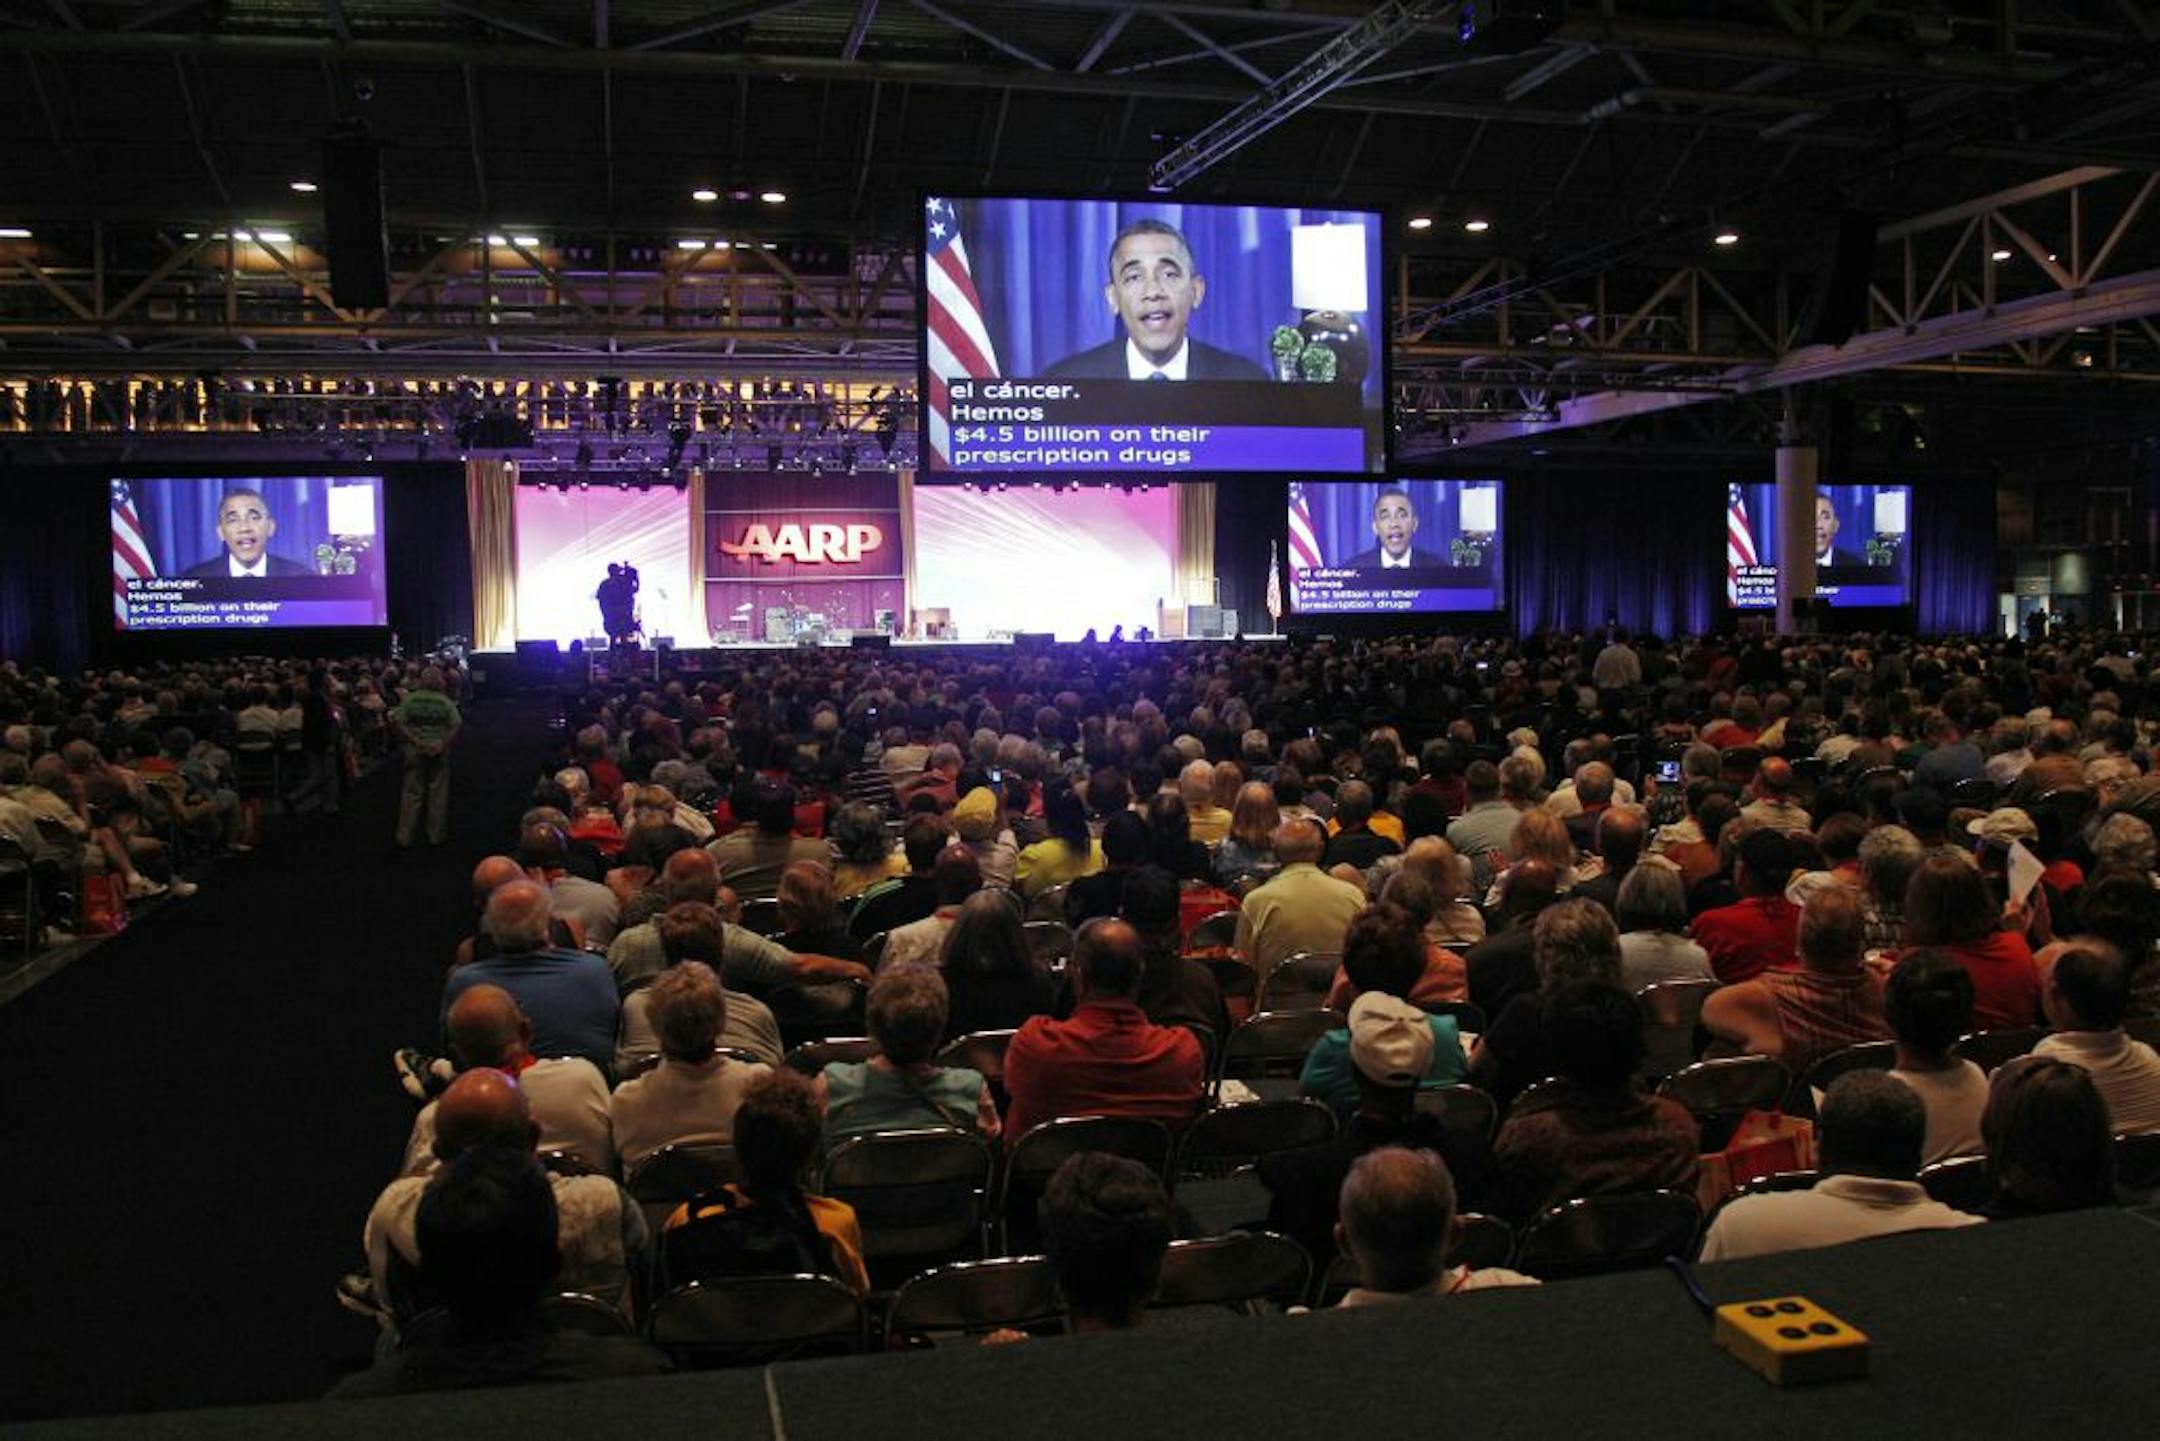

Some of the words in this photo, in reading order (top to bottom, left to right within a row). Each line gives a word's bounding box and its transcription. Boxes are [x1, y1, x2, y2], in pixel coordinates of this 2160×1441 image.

[950, 382, 974, 398] el
[983, 381, 1080, 398] cáncer.
[951, 404, 1044, 421] Hemos
[954, 426, 1014, 444] $4.5
[1024, 427, 1100, 442] billion
[1110, 428, 1141, 442] on
[1151, 426, 1210, 442] their
[954, 446, 1109, 464] prescription
[1119, 446, 1191, 464] drugs
[720, 523, 883, 563] AARP
[127, 579, 142, 589] el
[127, 592, 183, 601] Hemos
[130, 603, 166, 613] $4.5
[170, 602, 215, 613] billion
[220, 603, 239, 612] on
[244, 601, 281, 611] their
[130, 614, 221, 625] prescription
[225, 613, 269, 625] drugs
